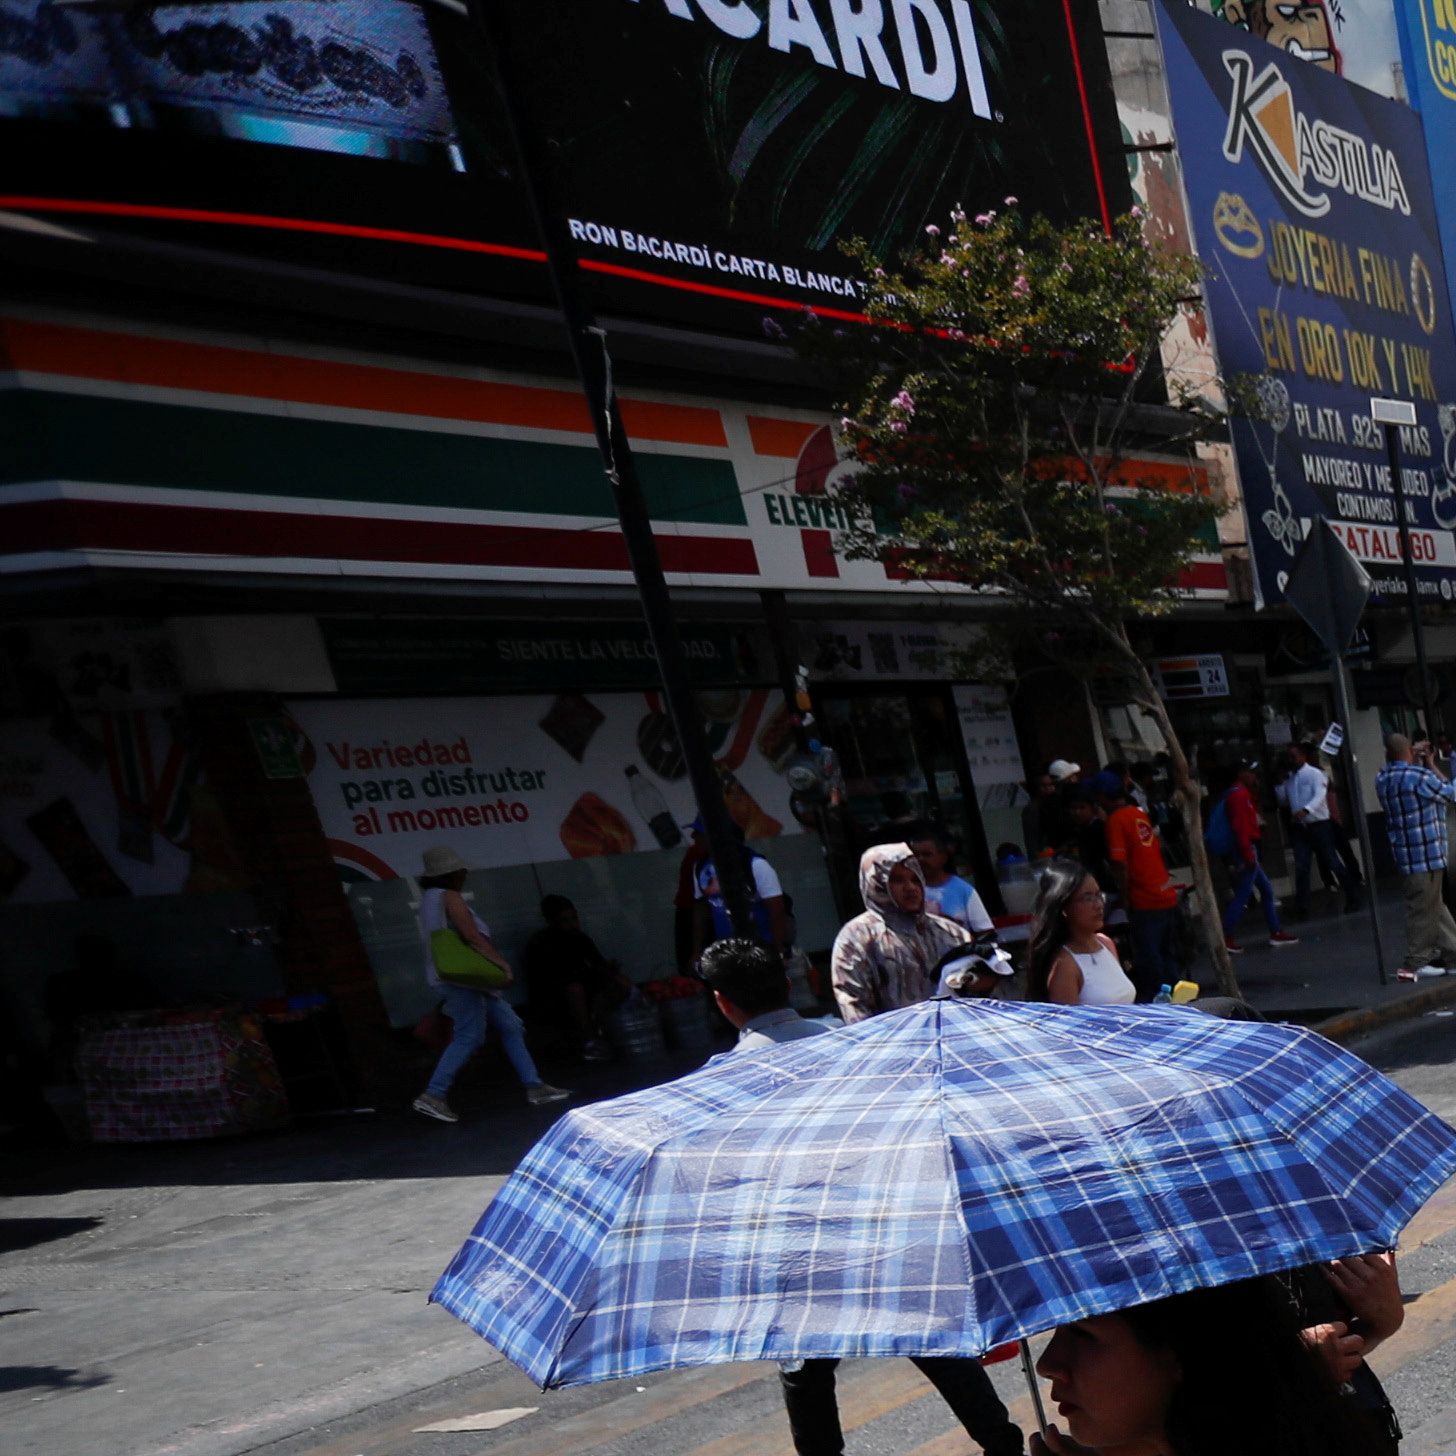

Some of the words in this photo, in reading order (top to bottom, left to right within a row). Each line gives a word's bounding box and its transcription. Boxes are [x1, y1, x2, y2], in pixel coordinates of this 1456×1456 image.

[567, 218, 619, 249] RON
[715, 252, 781, 284] CARTA
[783, 265, 858, 299] BLANCA
[1267, 219, 1360, 303] JOYERIA
[1357, 247, 1410, 317] FINA
[1257, 306, 1297, 373] EN
[1296, 316, 1344, 383] ORO
[1343, 328, 1383, 391] 10K
[1381, 337, 1399, 394] Y
[1401, 342, 1437, 400] 14K
[1293, 402, 1348, 445] PLATA
[1302, 453, 1364, 491] MAYOREO
[1363, 462, 1374, 491] Y
[1374, 464, 1430, 498] MEUDEO
[1336, 492, 1394, 523] CONTAMOS
[496, 639, 577, 662] SIENTE
[577, 640, 606, 660] LA
[327, 737, 473, 771] Variedad
[341, 774, 415, 809] para
[423, 766, 547, 799] disfrutar
[353, 806, 385, 837] al
[387, 800, 530, 833] momento
